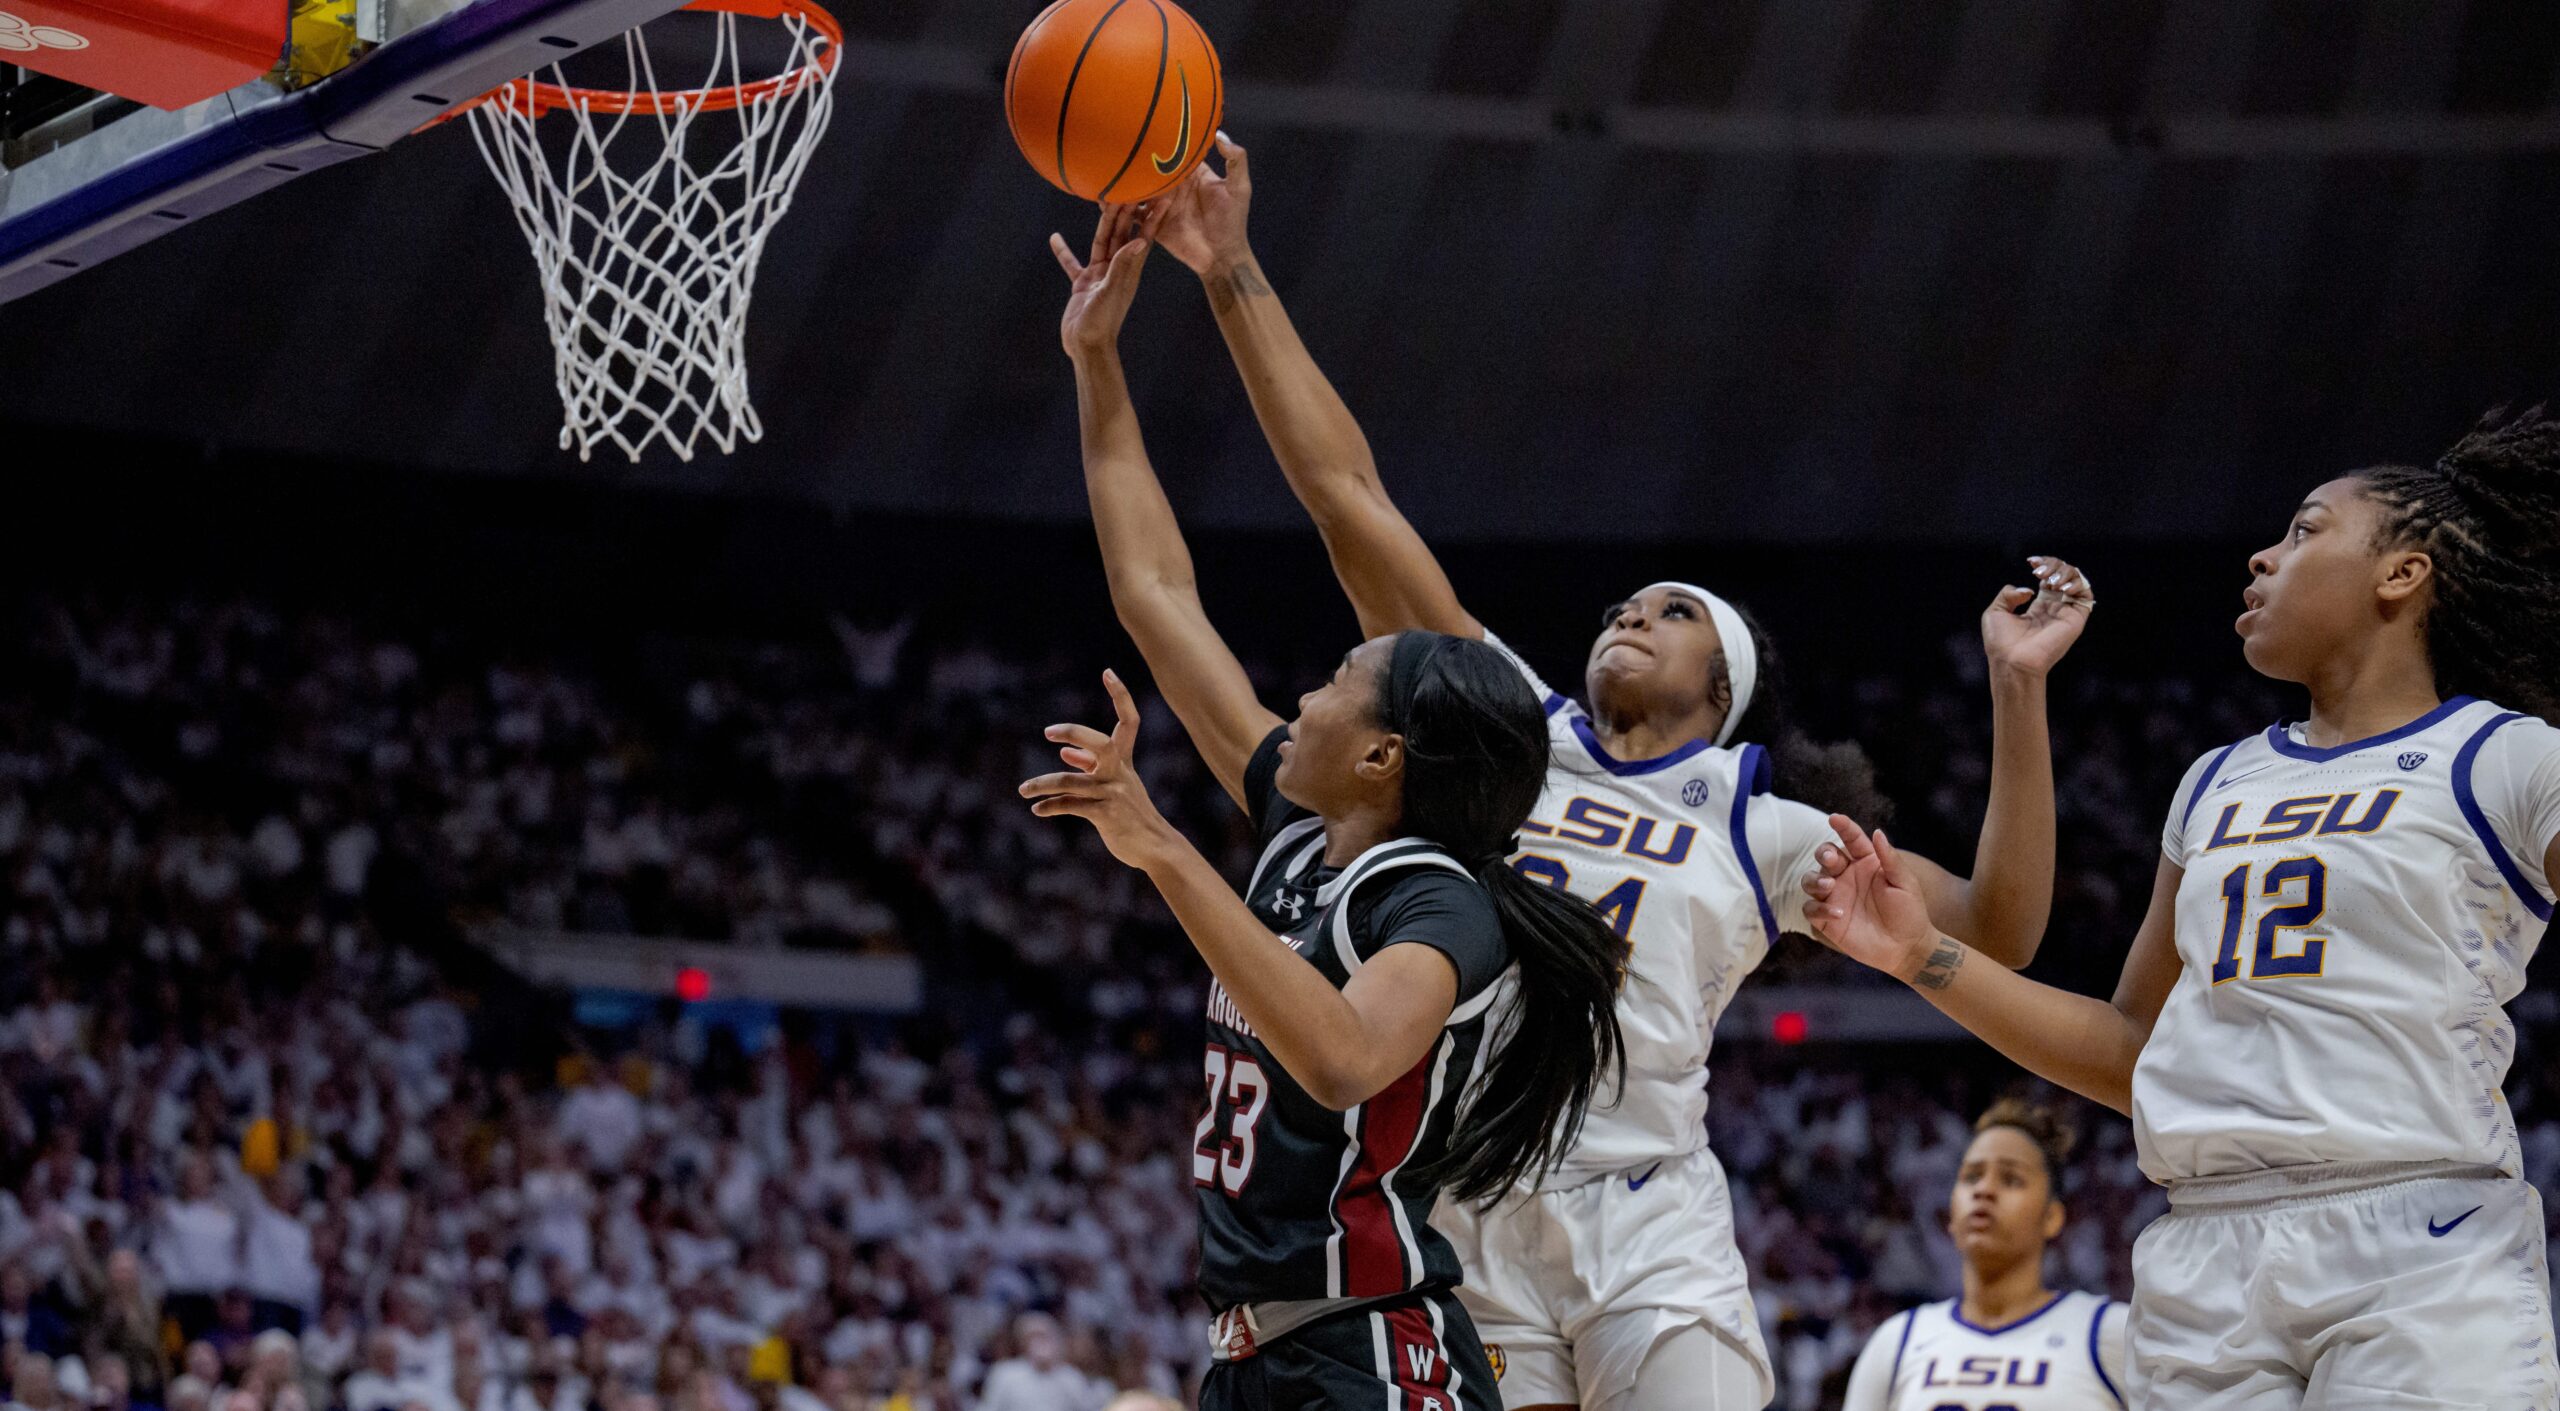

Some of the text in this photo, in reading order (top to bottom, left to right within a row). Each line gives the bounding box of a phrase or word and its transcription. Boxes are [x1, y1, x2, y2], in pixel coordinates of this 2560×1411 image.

[2398, 752, 2428, 772] SEC
[1682, 779, 1709, 807] SEC
[2203, 788, 2404, 854] LSU
[2211, 854, 2328, 986] 12
[1193, 1042, 1270, 1200] 23
[1922, 1354, 2052, 1389] LSU
